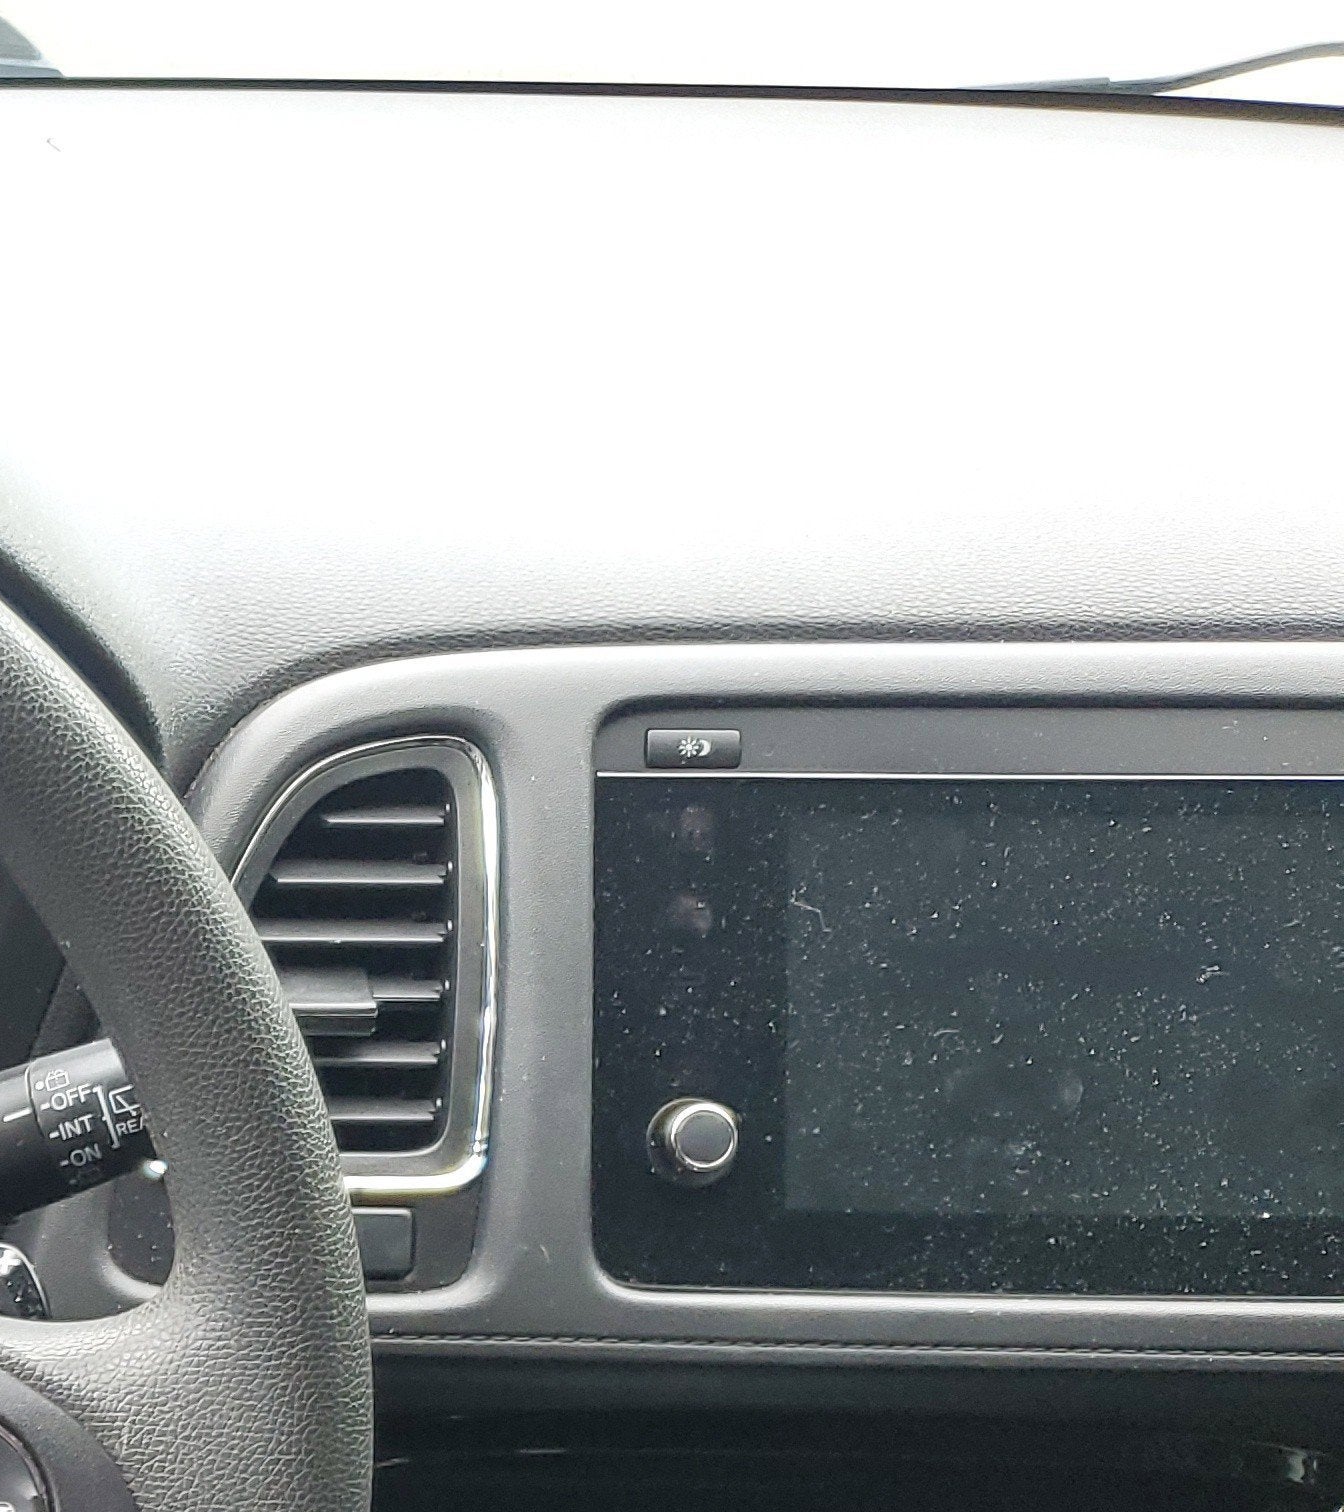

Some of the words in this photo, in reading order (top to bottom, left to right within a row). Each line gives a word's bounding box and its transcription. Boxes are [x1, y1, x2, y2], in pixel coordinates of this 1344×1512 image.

[52, 1083, 92, 1110] OFF
[58, 1114, 93, 1140] INT
[70, 1143, 102, 1166] ON
